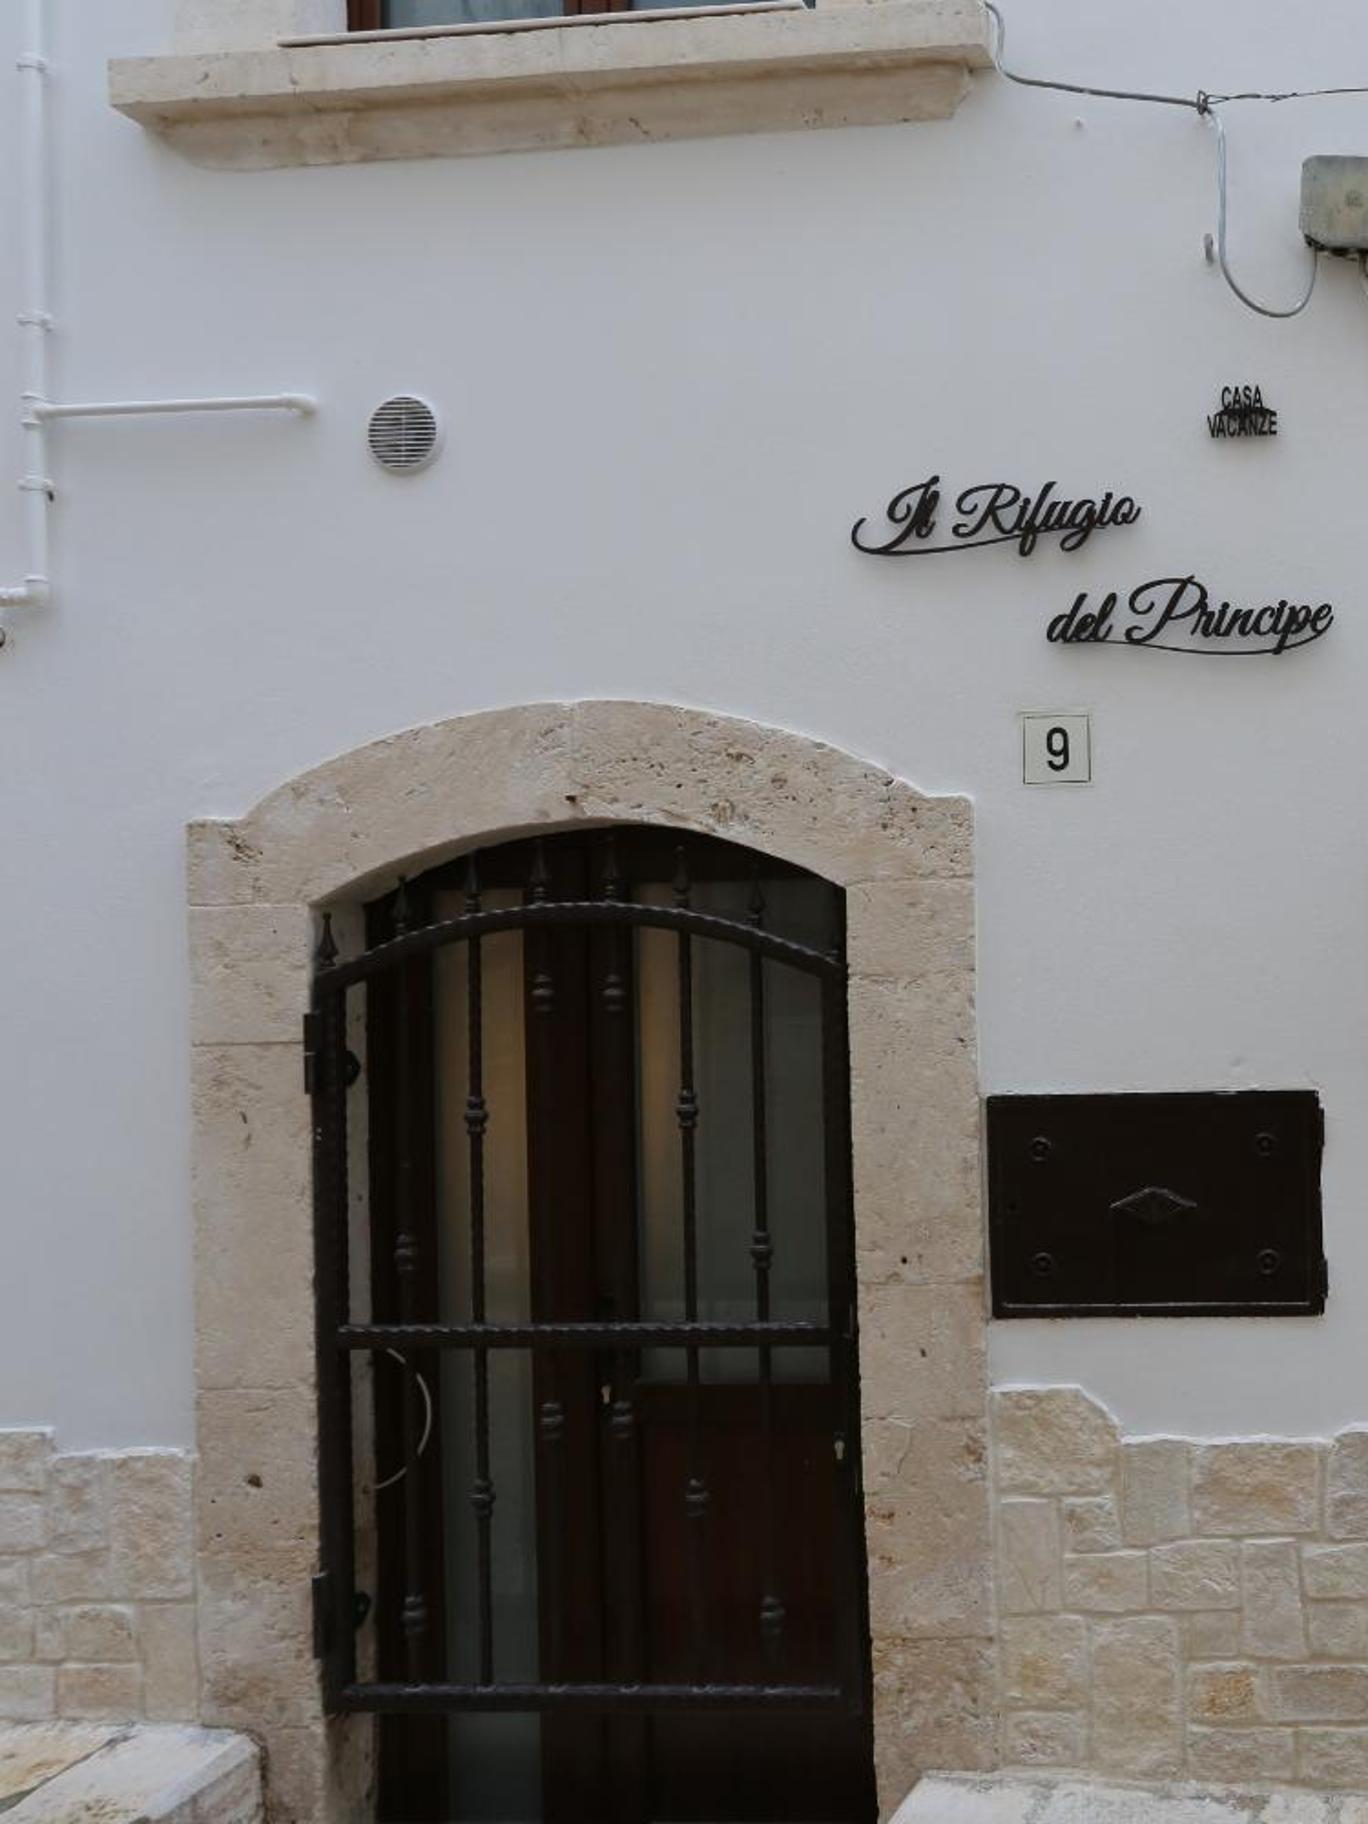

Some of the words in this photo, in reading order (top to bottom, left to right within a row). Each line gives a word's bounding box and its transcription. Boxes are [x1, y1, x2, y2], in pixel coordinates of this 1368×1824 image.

[1221, 384, 1263, 409] CASA
[1207, 410, 1277, 438] VACANZE
[852, 475, 941, 554] Il
[951, 481, 1141, 556] Rifugio
[1047, 593, 1116, 643] del
[1124, 575, 1334, 655] Principe
[1045, 727, 1071, 772] 9
